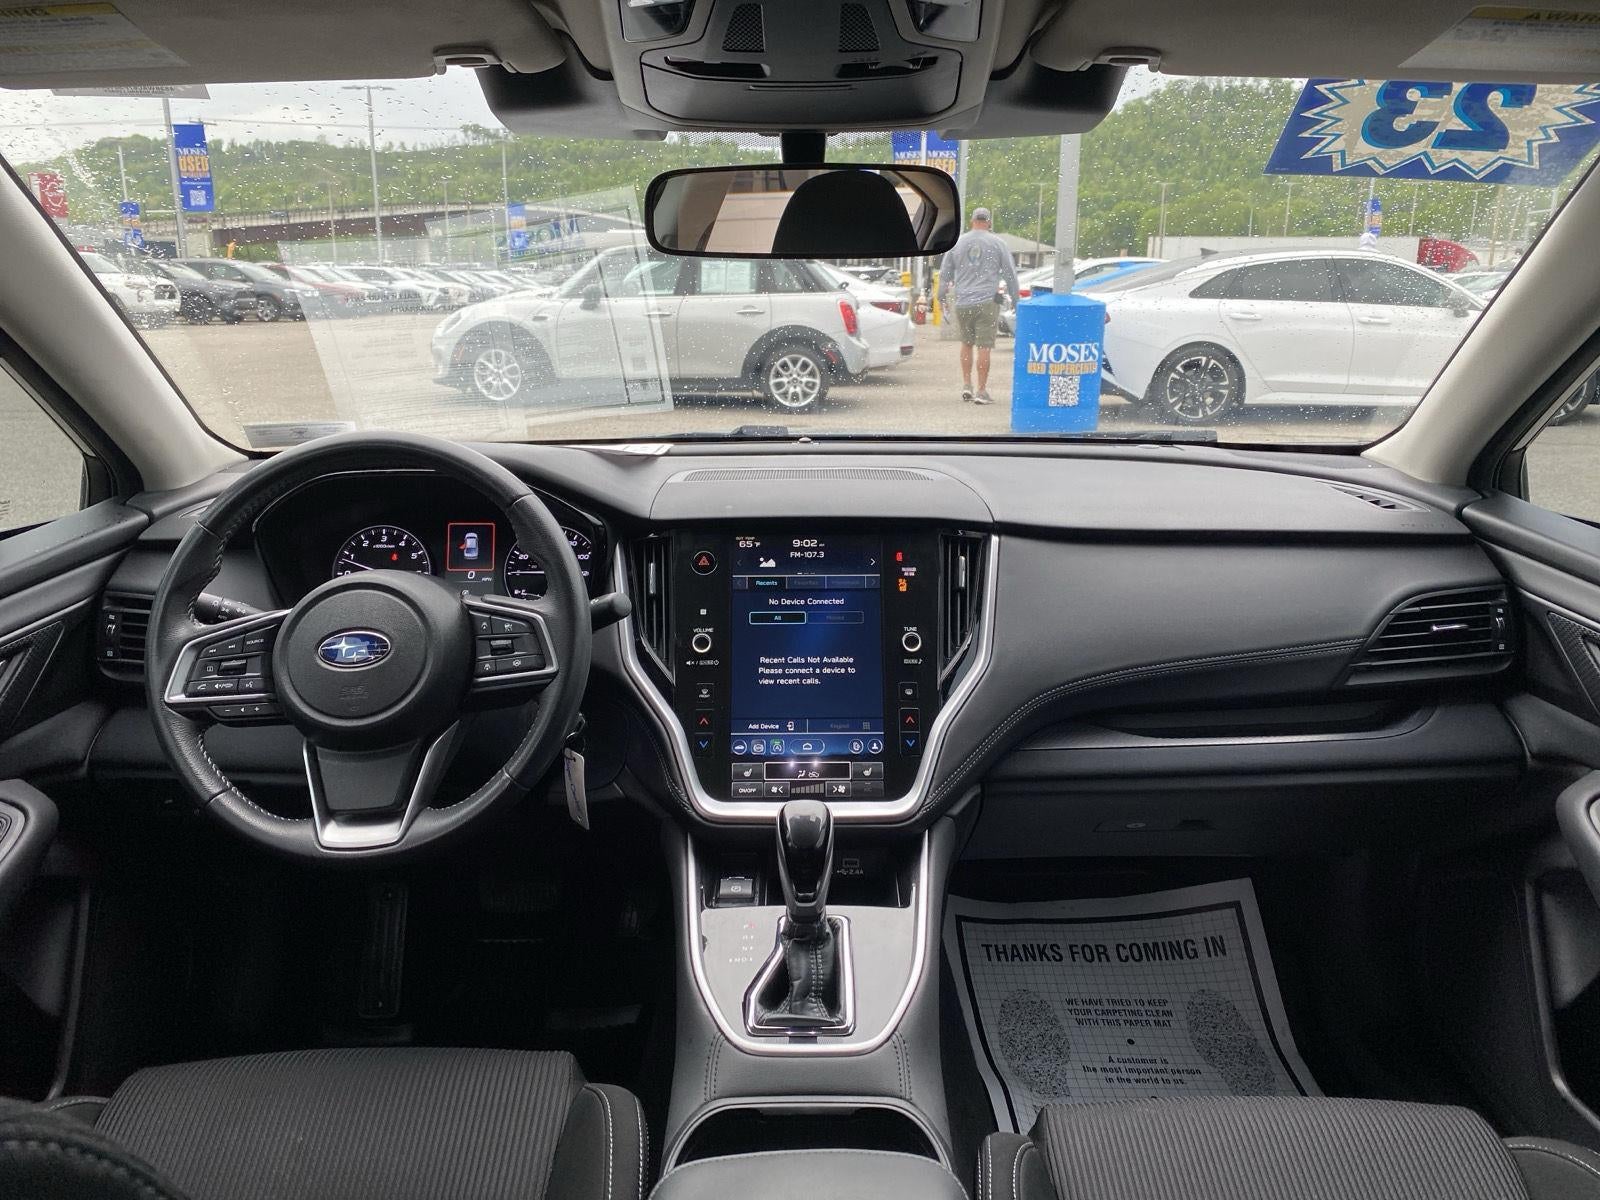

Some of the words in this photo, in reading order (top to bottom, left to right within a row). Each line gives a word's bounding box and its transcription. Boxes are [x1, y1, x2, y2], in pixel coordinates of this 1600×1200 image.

[927, 150, 957, 158] MOSES
[1028, 342, 1100, 363] MOSES
[792, 539, 818, 547] 9:02
[411, 552, 418, 560] 5
[467, 570, 476, 579] 0
[760, 656, 785, 664] Recent
[787, 656, 805, 664] Calls
[807, 656, 821, 664] Not
[848, 666, 856, 674] to
[802, 677, 821, 685] calls.
[980, 943, 1064, 963] THANKS
[1068, 944, 1111, 963] FOR
[1115, 938, 1199, 963] COMING
[1203, 935, 1228, 958] IN
[1065, 998, 1080, 1006] WE
[1081, 998, 1105, 1006] HAVE
[1106, 998, 1132, 1006] TRIED
[1133, 998, 1145, 1006] TO
[1146, 998, 1169, 1007] KEEP
[1068, 1008, 1093, 1016] YOUR
[1094, 1008, 1143, 1017] CARPETING
[1145, 1009, 1174, 1018] CLEAN
[1075, 1018, 1100, 1026] WITH
[1100, 1018, 1121, 1027] THIS
[1123, 1019, 1152, 1027] PAPER
[1153, 1019, 1172, 1028] MAT
[1108, 1055, 1115, 1064] A
[1160, 1057, 1169, 1065] is
[1082, 1065, 1098, 1073] the
[1100, 1066, 1123, 1074] most
[1124, 1066, 1169, 1076] important
[1170, 1067, 1202, 1076] person
[1105, 1076, 1115, 1084] in
[1116, 1076, 1132, 1084] the
[1133, 1076, 1160, 1084] world
[1162, 1077, 1171, 1085] to
